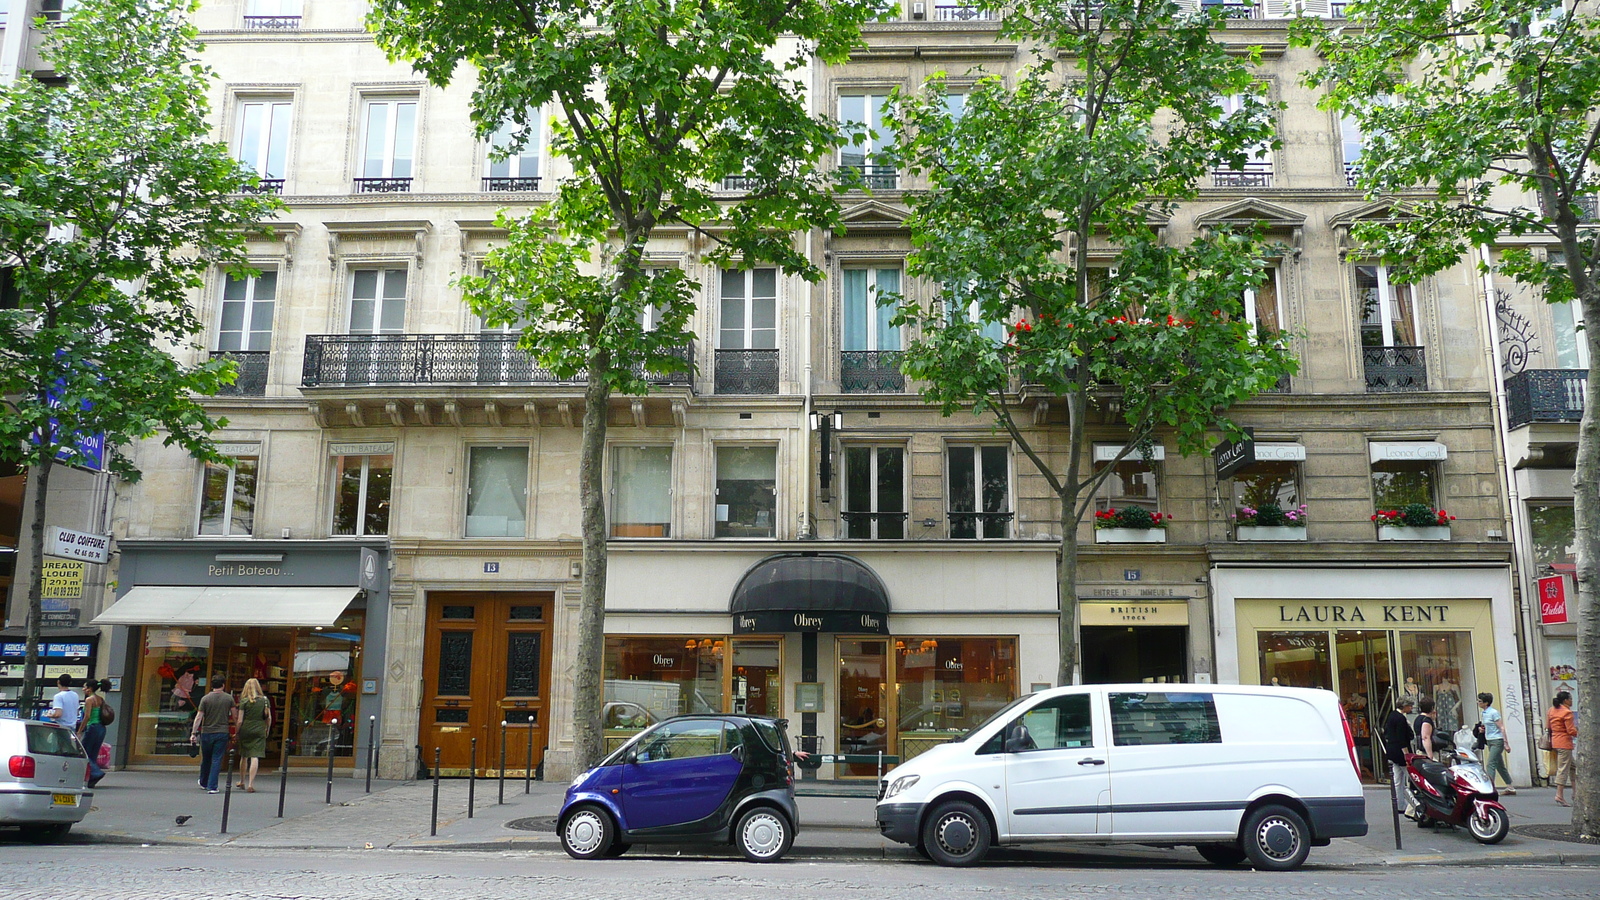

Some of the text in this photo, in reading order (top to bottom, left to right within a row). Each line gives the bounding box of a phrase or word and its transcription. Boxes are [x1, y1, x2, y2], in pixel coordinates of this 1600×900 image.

[335, 444, 389, 453] PETIT BATEAU
[1255, 449, 1272, 458] onor
[1385, 446, 1414, 458] Leonor
[58, 531, 106, 550] CLUB COIFFURE
[42, 562, 83, 570] UREAUX
[208, 564, 235, 577] Petit
[238, 563, 280, 576] Bateau
[487, 562, 496, 572] 13
[46, 570, 79, 578] LOUER
[1127, 570, 1137, 580] 15
[1093, 588, 1119, 597] ENTREE
[1134, 588, 1174, 597] 'IMMEUBE
[1278, 605, 1449, 623] LAURA KENT
[793, 612, 824, 631] Obrey
[860, 613, 880, 632] Obrey
[4, 643, 20, 652] AGENCE
[48, 643, 66, 652] AGENCE
[71, 644, 90, 652] VOYAGES
[653, 653, 675, 668] Obrey
[945, 659, 964, 671] Obrey
